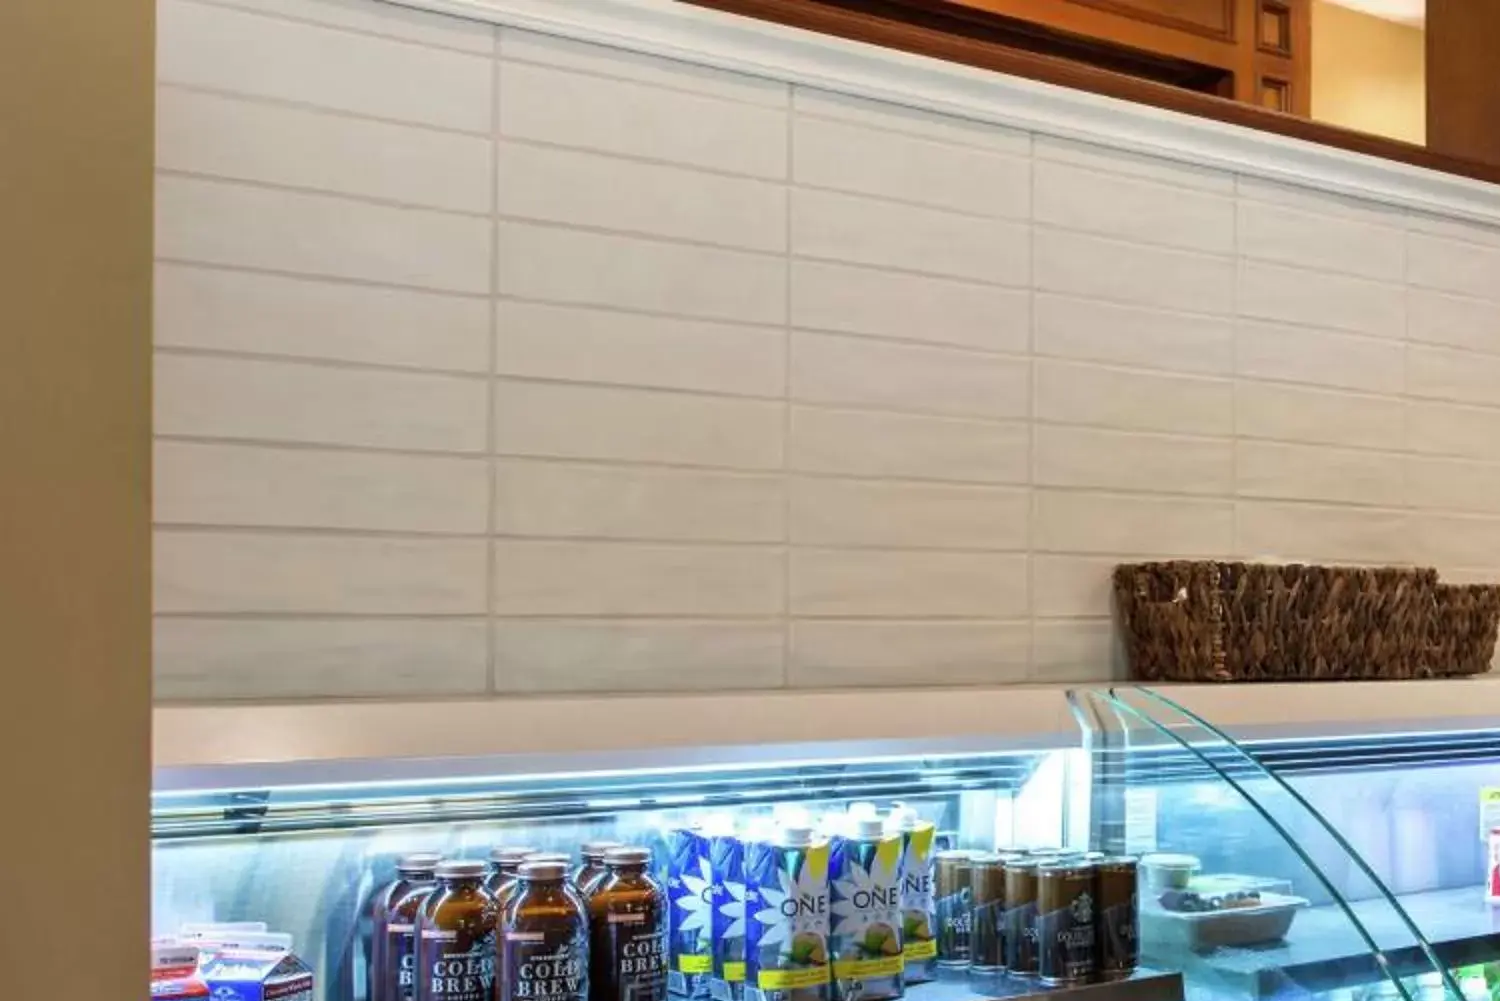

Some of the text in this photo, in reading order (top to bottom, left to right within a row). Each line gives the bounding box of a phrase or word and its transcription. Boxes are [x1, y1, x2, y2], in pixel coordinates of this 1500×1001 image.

[900, 874, 930, 894] NE
[433, 957, 495, 978] COLD
[519, 957, 582, 980] COLD
[431, 974, 495, 994] BREW
[516, 979, 580, 998] BREW
